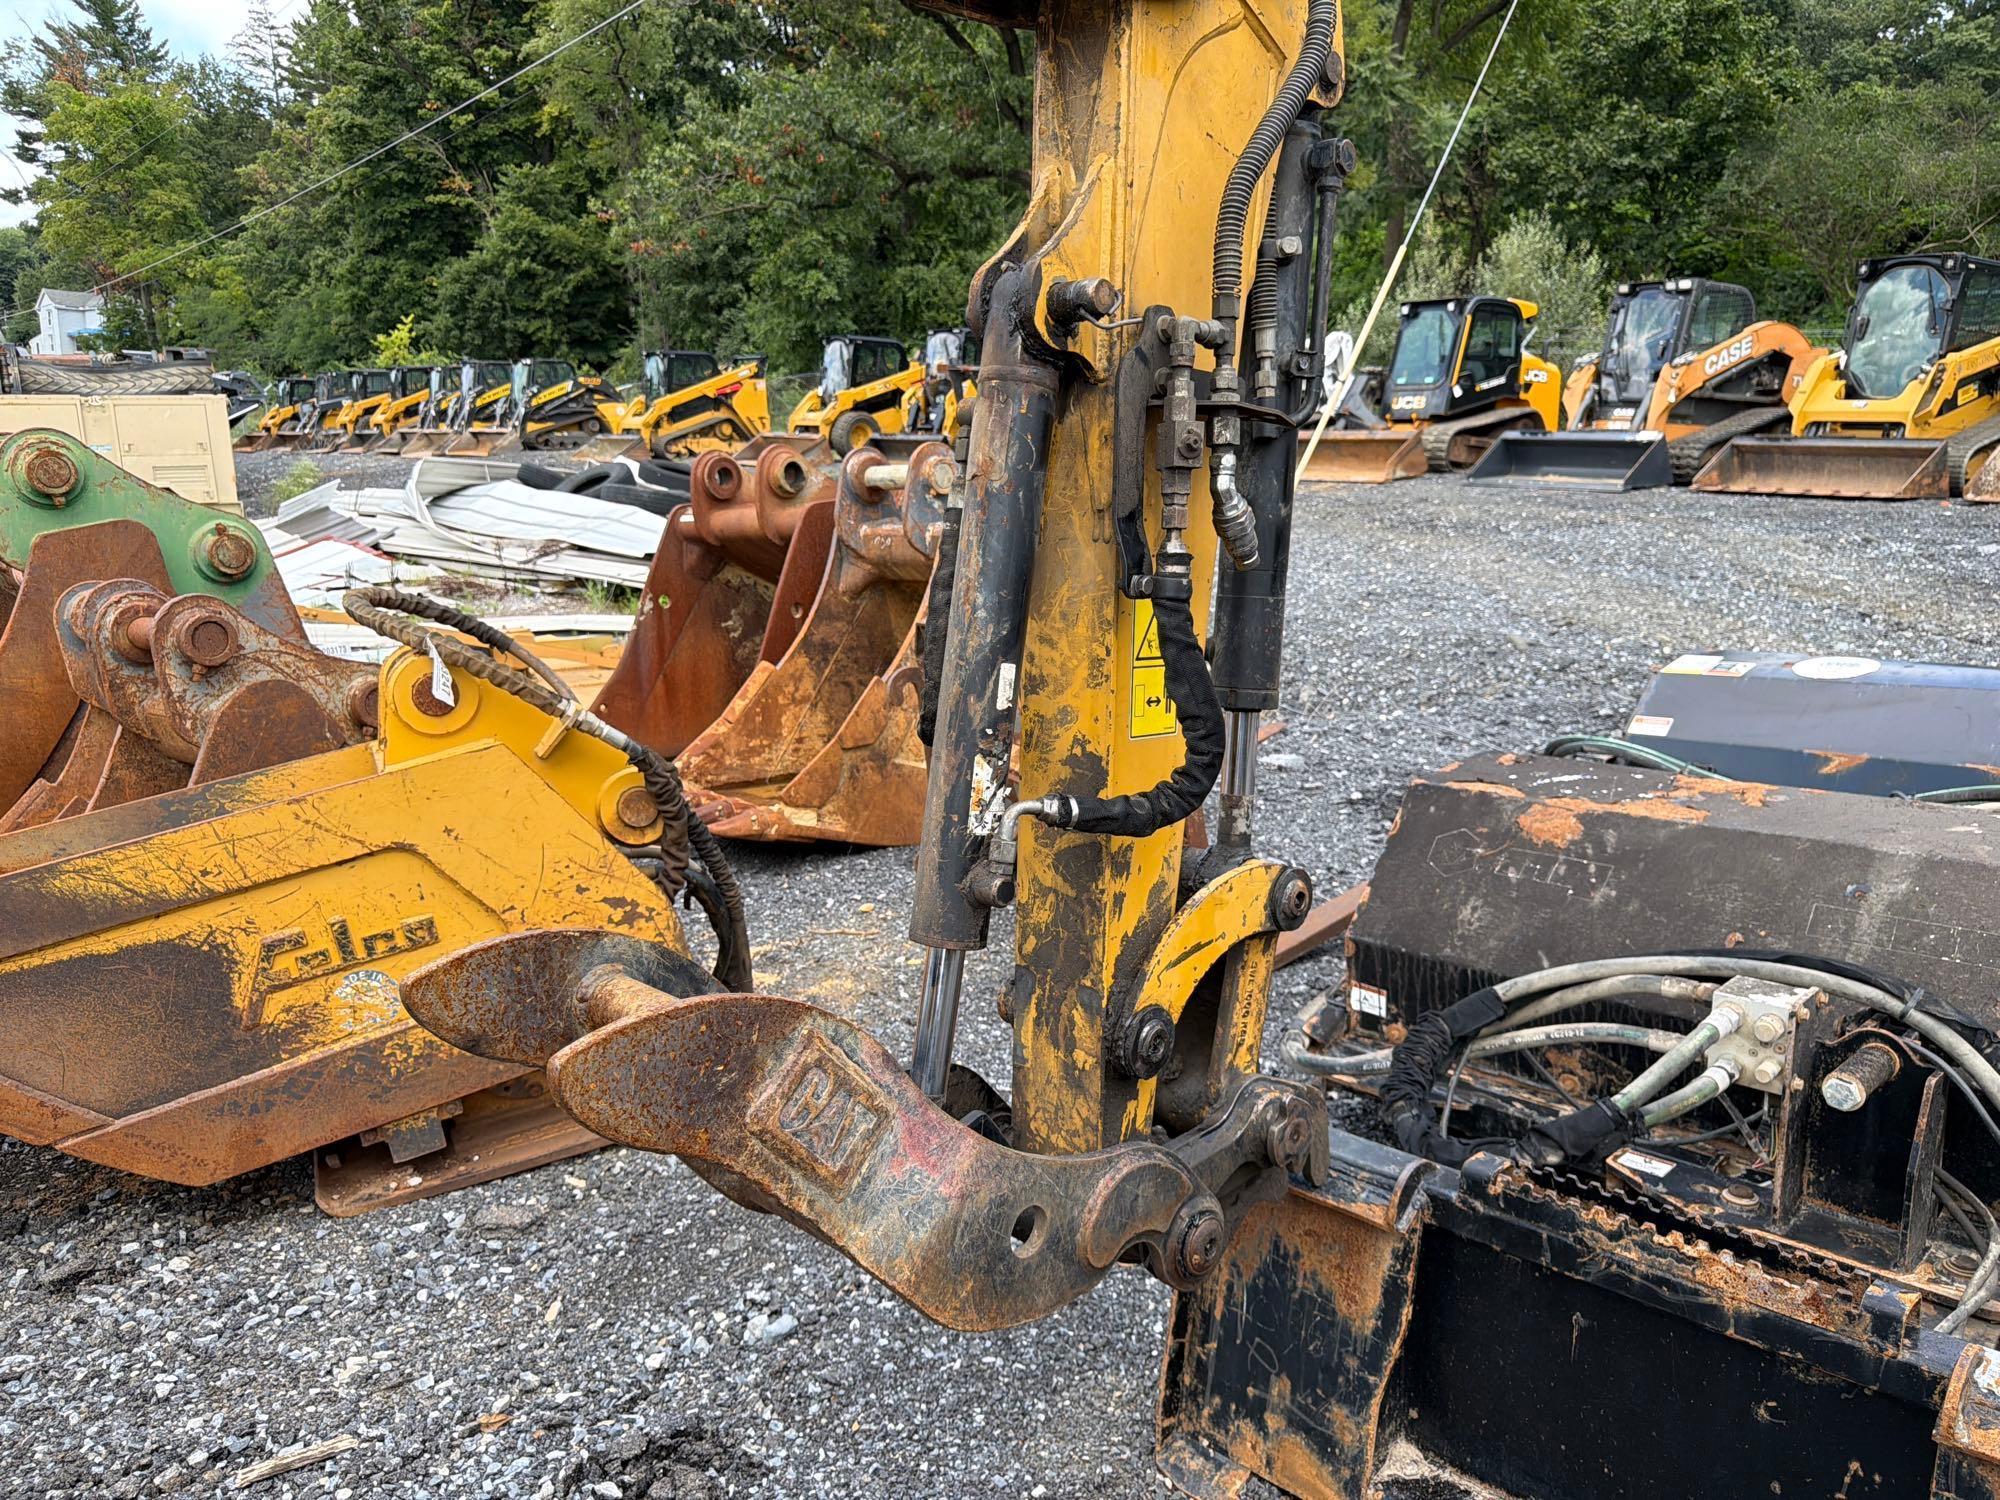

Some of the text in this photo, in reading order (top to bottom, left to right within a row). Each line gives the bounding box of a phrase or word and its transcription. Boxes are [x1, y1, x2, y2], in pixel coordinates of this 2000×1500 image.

[1704, 335, 1753, 375] CASE
[1524, 370, 1548, 383] JCB
[1391, 395, 1427, 410] JCB
[779, 1065, 878, 1171] CAT
